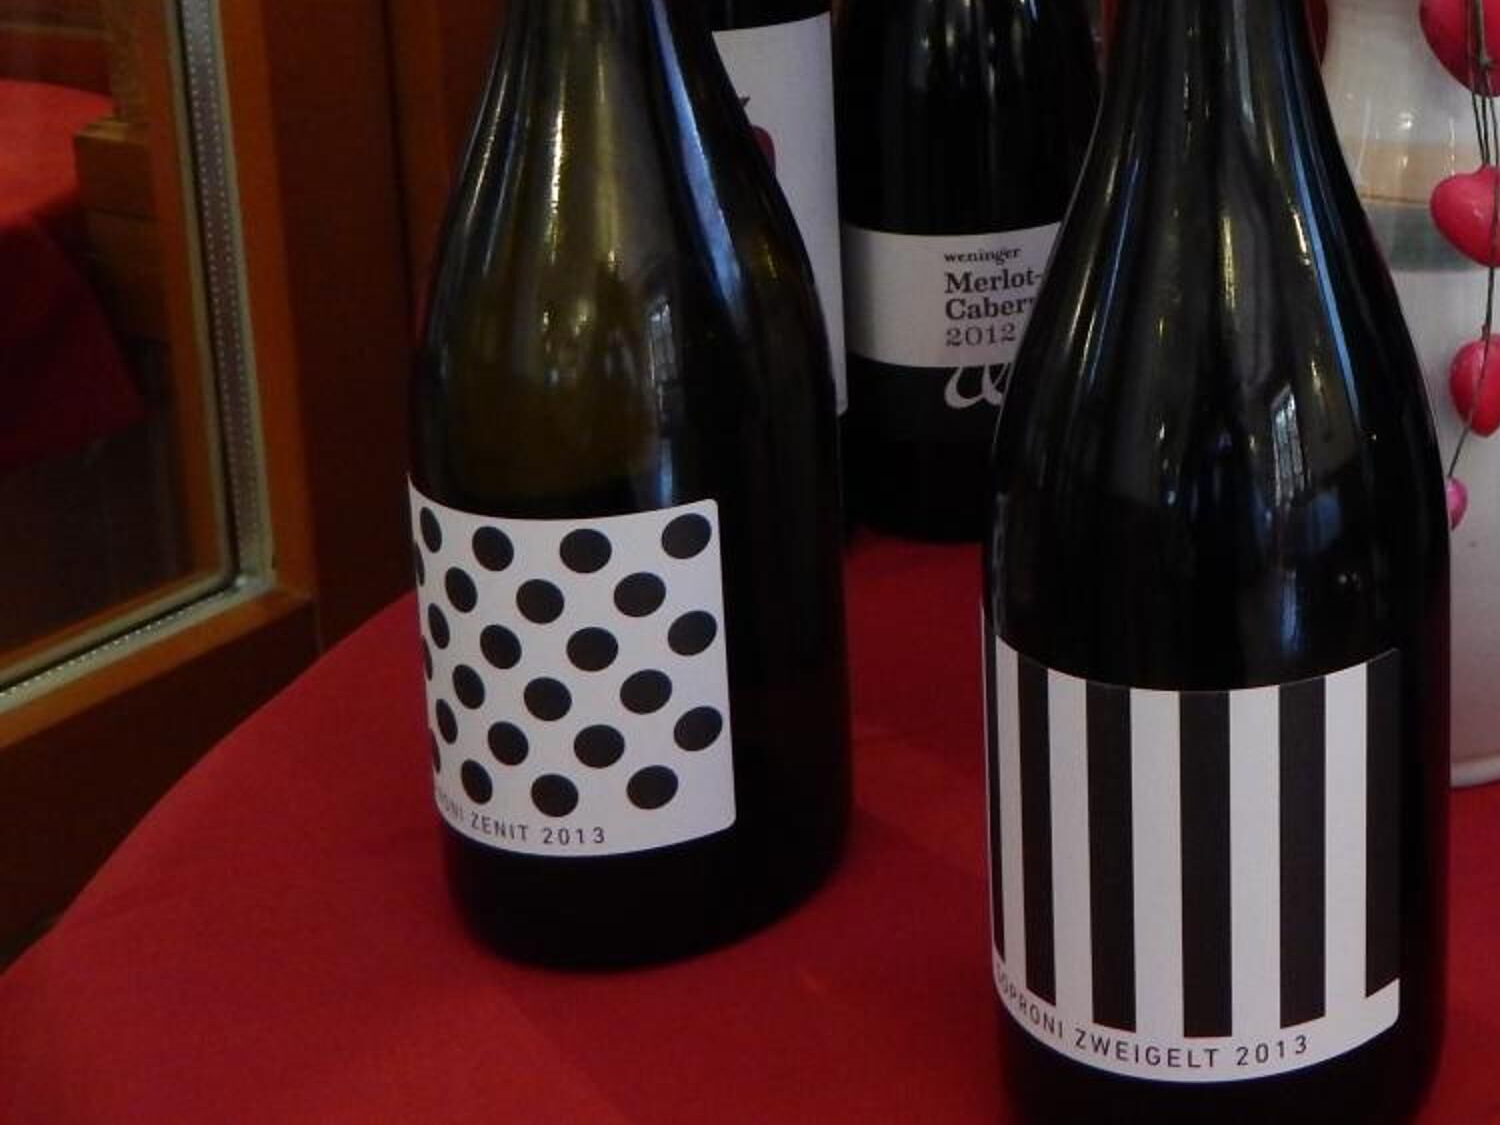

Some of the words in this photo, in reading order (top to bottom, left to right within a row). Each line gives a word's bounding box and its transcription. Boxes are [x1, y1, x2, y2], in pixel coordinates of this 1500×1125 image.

[944, 247, 1021, 265] weninger
[944, 267, 1041, 294] Merlot-
[945, 296, 1036, 321] Caber
[945, 322, 1016, 347] 2012
[470, 811, 529, 843] ZENIT
[542, 826, 606, 846] 2013
[1074, 1027, 1220, 1069] ZWEIGELT
[1236, 1034, 1308, 1067] 2013
